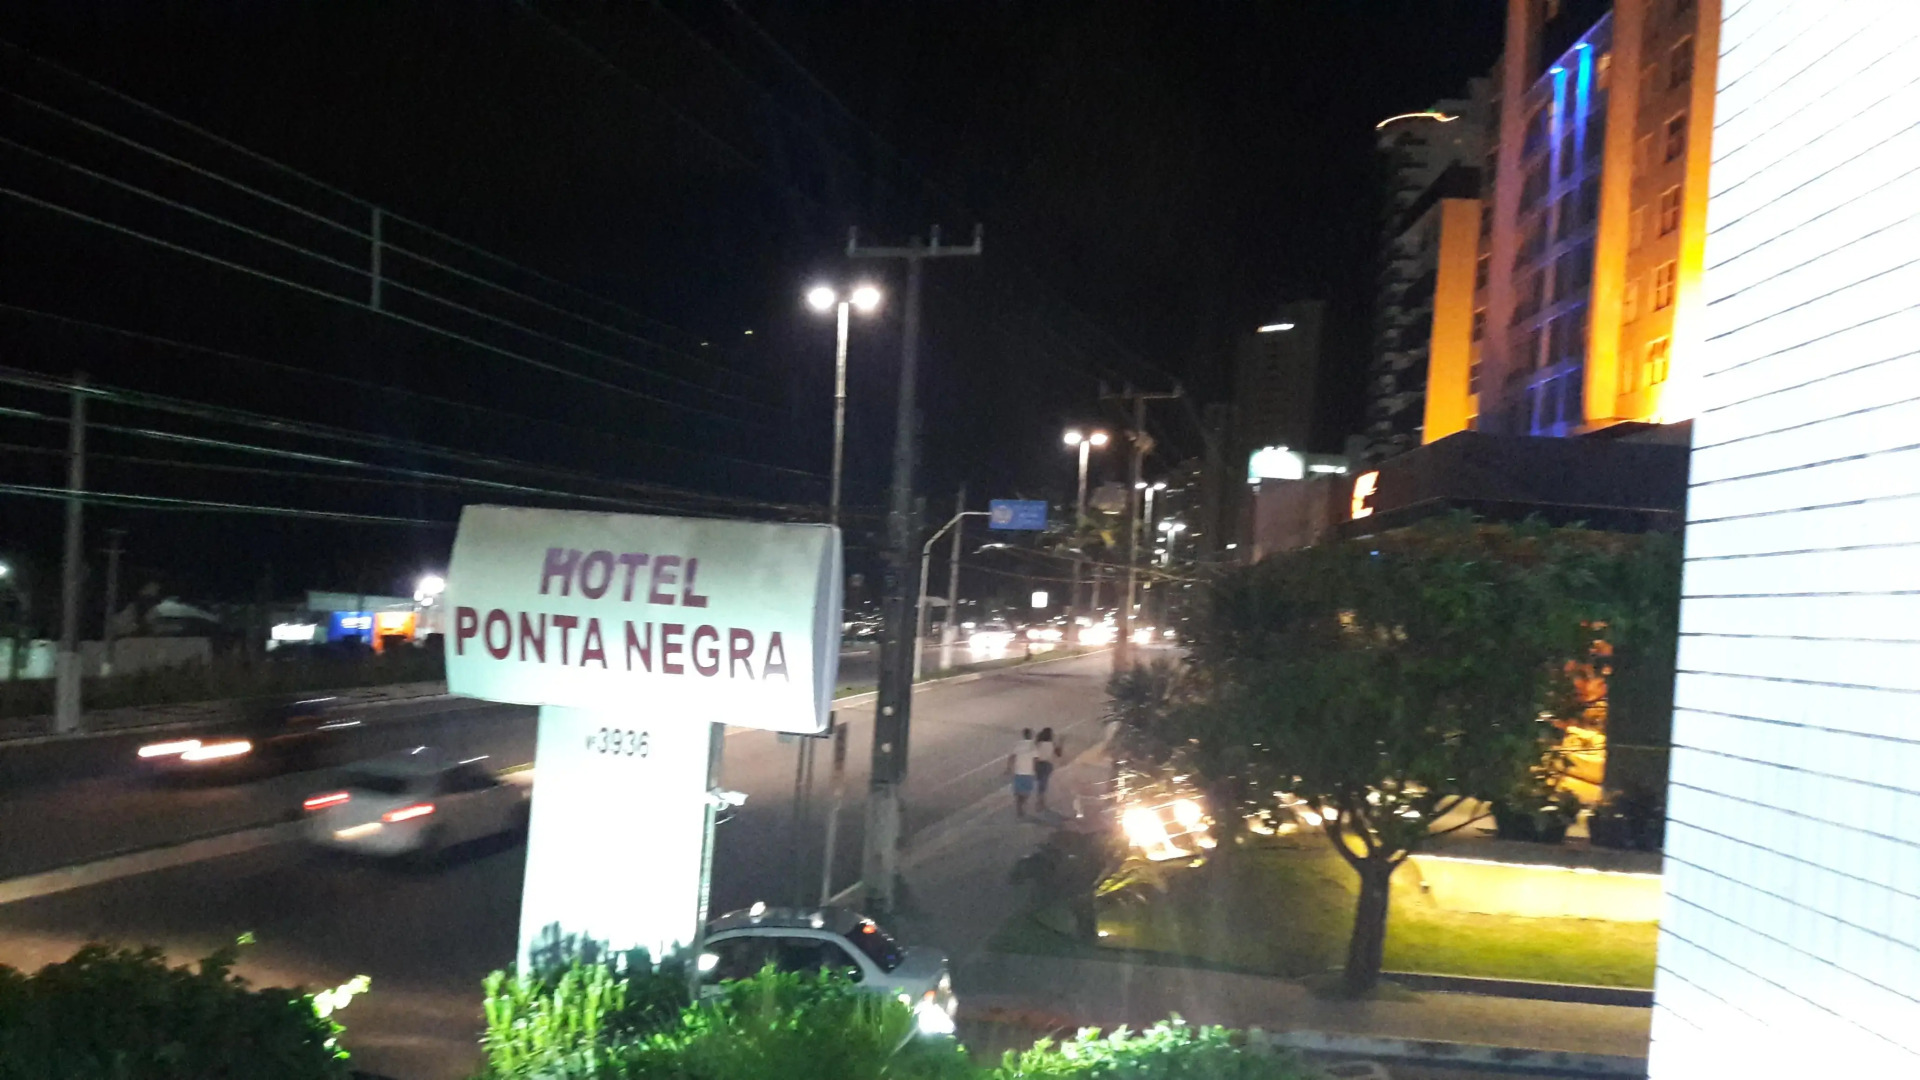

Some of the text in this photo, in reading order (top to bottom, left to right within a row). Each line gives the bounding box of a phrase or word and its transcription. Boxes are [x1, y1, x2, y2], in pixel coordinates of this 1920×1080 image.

[539, 547, 709, 608] HOTEL
[455, 607, 790, 683] PONTA NEGRA
[598, 727, 649, 758] 3936
